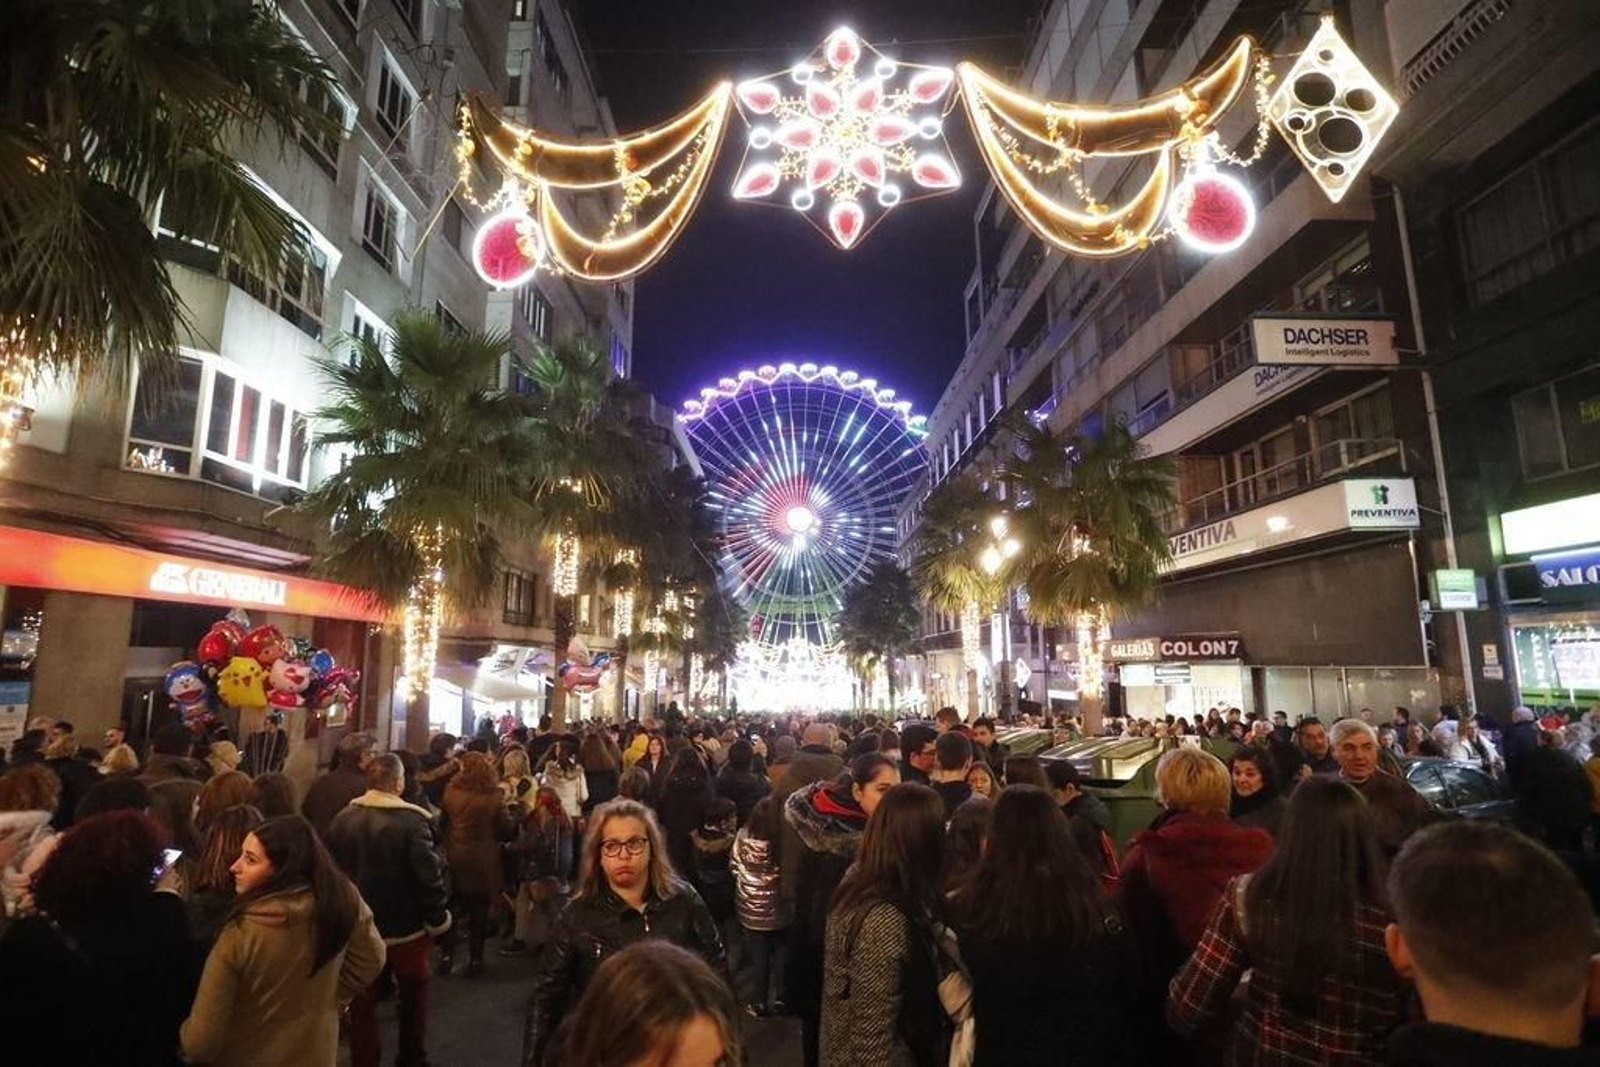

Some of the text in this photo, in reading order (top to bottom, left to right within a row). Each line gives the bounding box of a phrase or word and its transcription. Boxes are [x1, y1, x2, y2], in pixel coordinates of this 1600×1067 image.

[1283, 328, 1370, 345] DACHSER
[1285, 347, 1371, 357] Intelligent Logistics
[1350, 508, 1417, 518] PREVENTIVA
